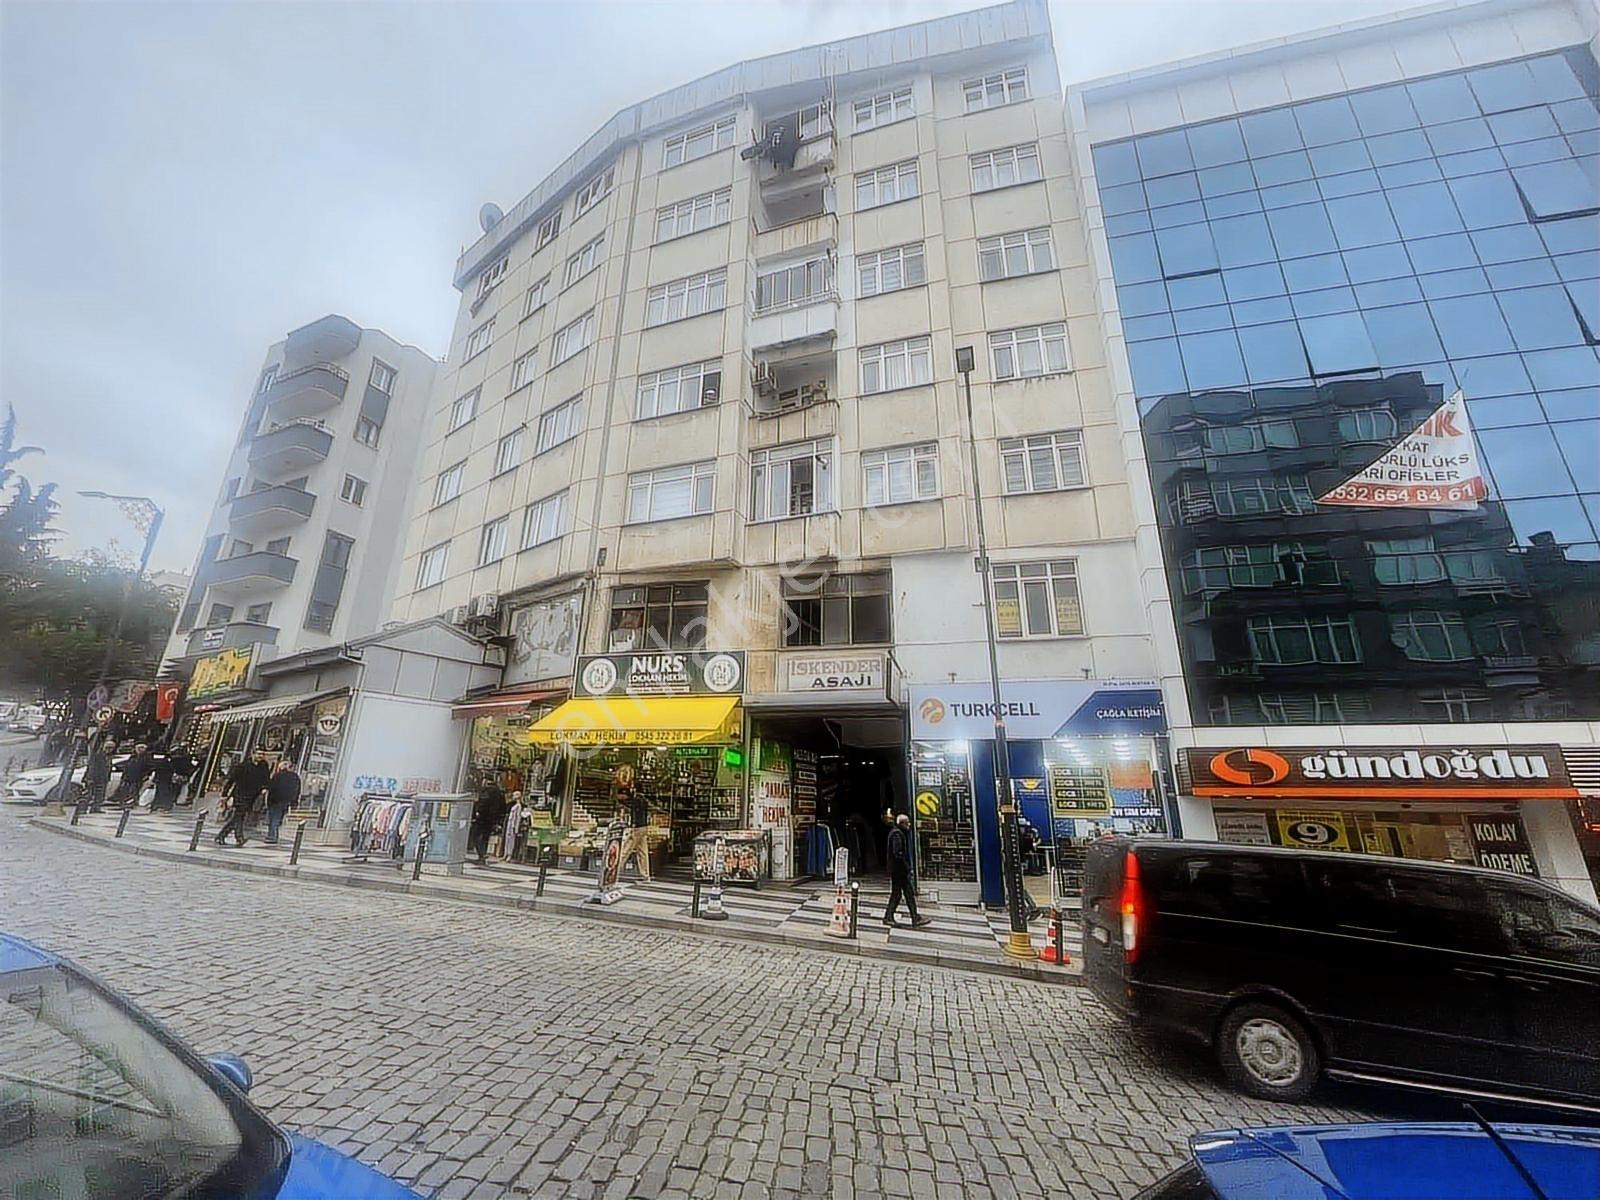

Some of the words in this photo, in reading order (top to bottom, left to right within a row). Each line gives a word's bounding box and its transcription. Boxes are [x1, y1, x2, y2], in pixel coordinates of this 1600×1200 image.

[1402, 441, 1430, 453] KAT
[1422, 453, 1470, 468] LÜKS
[1388, 469, 1460, 482] OFİSLER
[1374, 488, 1409, 502] 654
[1417, 489, 1442, 502] 84
[1448, 484, 1475, 501] 61
[631, 654, 684, 674] NURS
[950, 702, 1040, 717] TURKCELL
[1301, 749, 1549, 779] gündoğdu
[1297, 823, 1329, 844] 9
[1473, 823, 1518, 842] KOLAY
